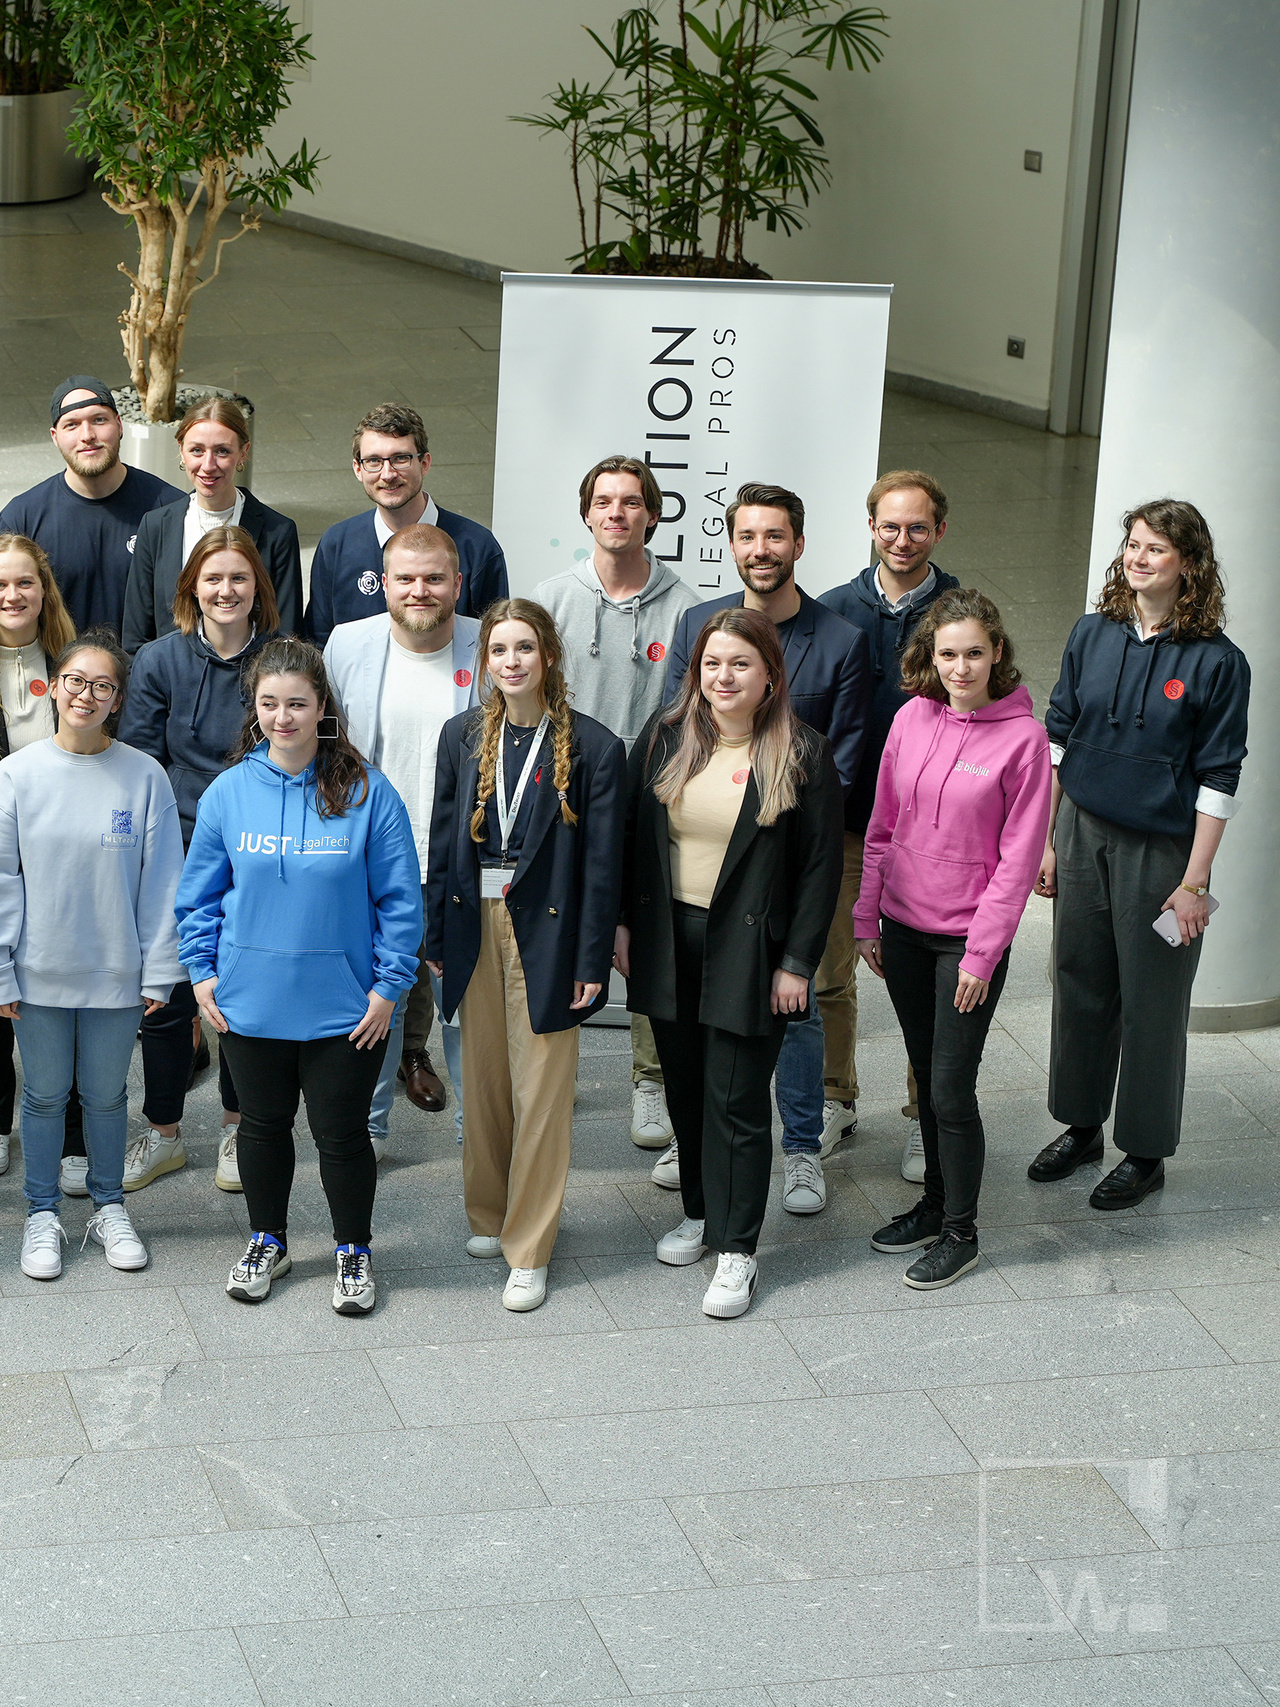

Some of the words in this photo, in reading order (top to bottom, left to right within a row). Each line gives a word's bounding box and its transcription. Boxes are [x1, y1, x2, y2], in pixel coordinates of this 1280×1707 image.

[707, 327, 736, 434] PROS
[698, 461, 728, 588] LEGAL
[236, 831, 293, 856] JUST
[293, 835, 350, 851] LegalTech
